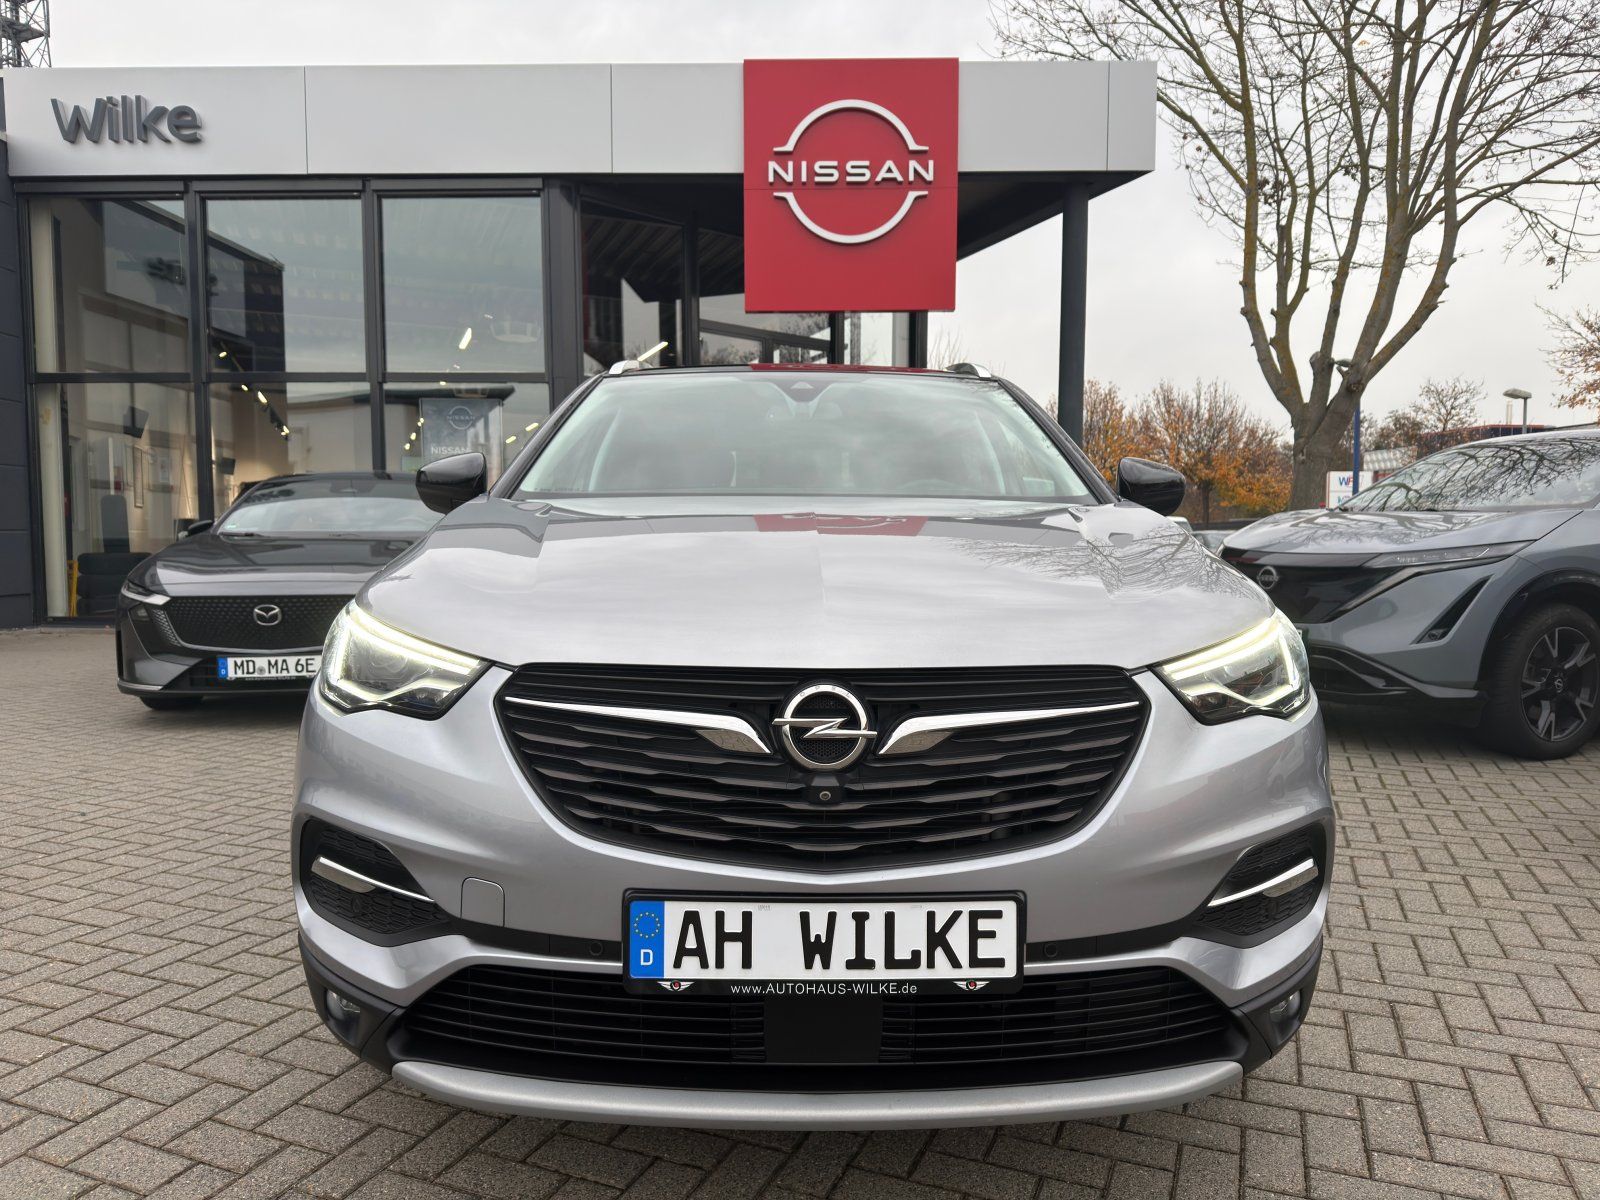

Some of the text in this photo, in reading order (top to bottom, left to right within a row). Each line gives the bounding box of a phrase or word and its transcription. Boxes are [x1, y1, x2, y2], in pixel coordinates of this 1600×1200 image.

[50, 95, 203, 144] Wilke
[767, 159, 935, 184] NISSAN
[234, 658, 316, 675] MD MA 6E
[672, 910, 1006, 970] AH WILKE
[640, 949, 654, 966] D
[730, 982, 918, 995] www.AUTOHAUS-WILKE.de
